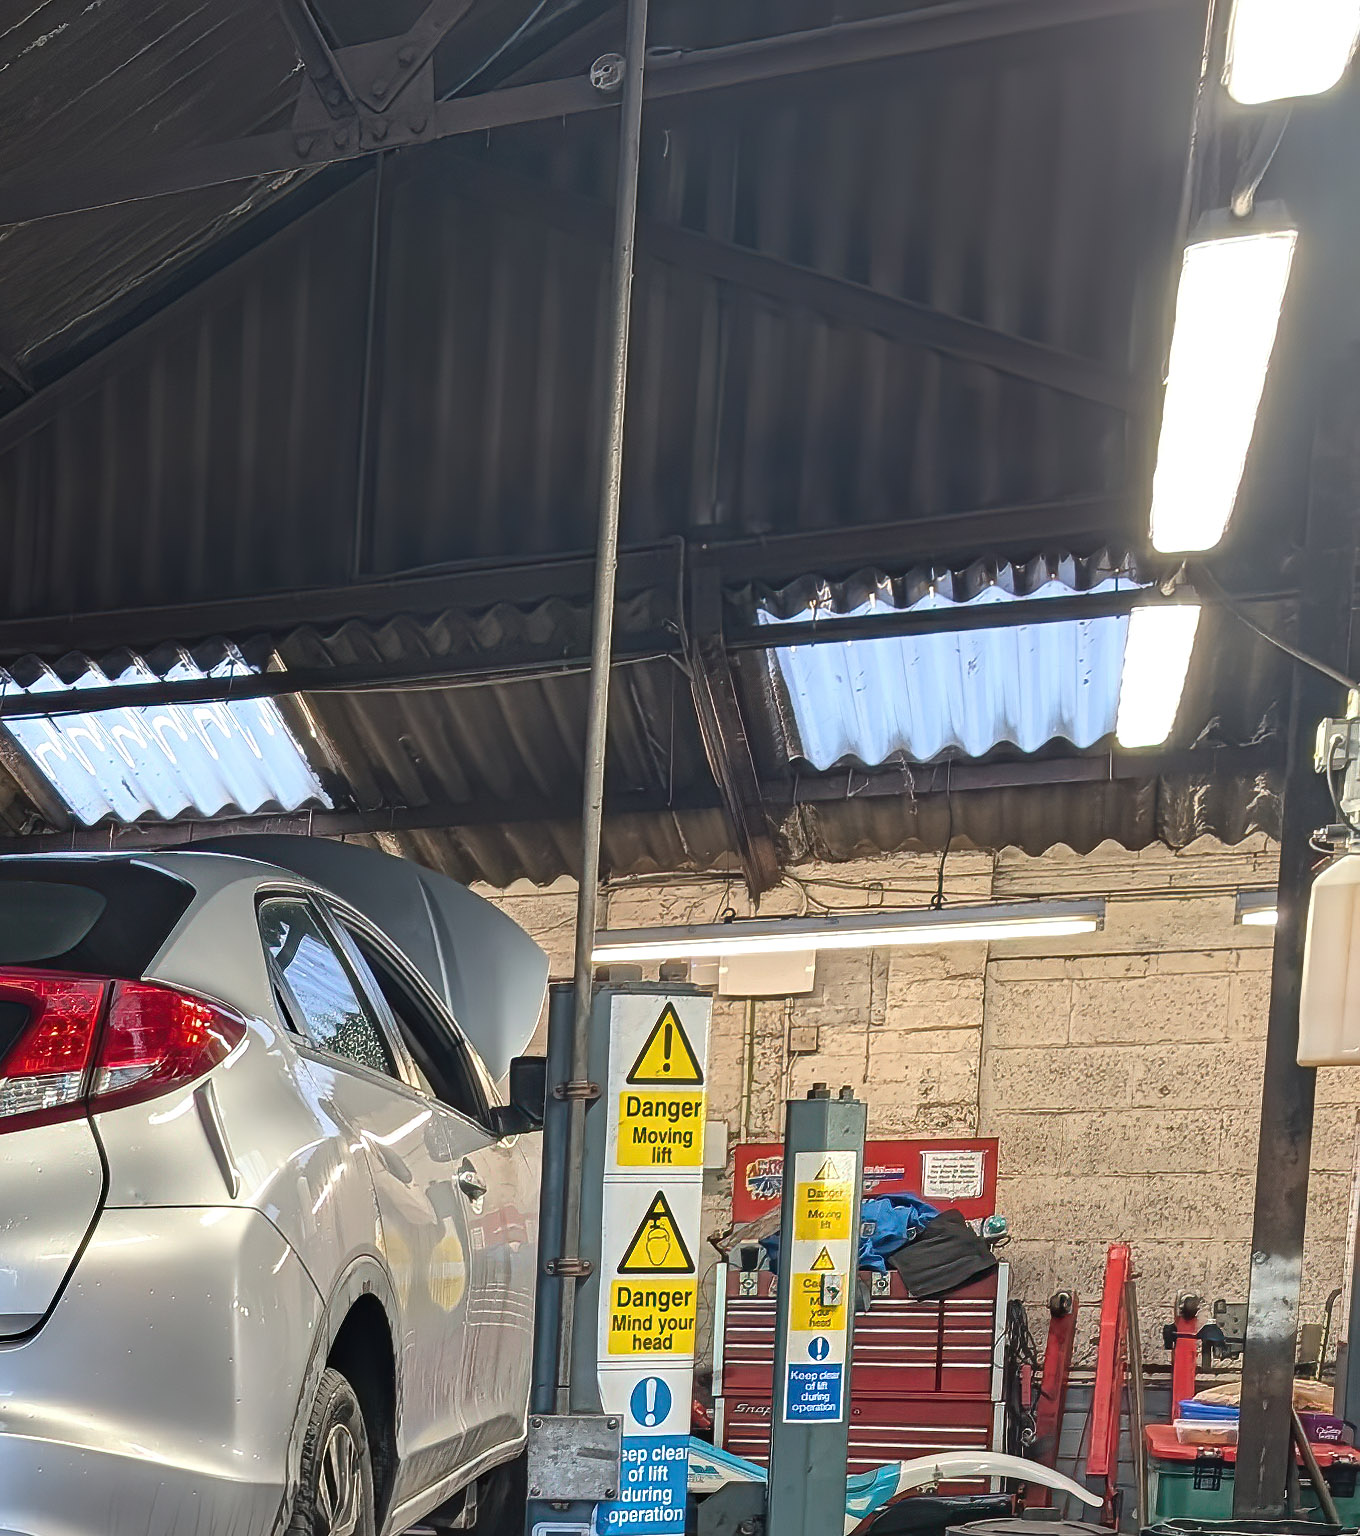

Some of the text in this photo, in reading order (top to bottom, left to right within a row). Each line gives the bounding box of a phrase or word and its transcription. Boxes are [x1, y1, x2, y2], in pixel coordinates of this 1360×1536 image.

[626, 1095, 702, 1123] Danger
[632, 1126, 694, 1148] Moving
[651, 1146, 673, 1164] lift
[616, 1286, 693, 1313] Danger
[611, 1314, 695, 1336] Mind your
[632, 1333, 673, 1351] head
[790, 1370, 818, 1382] Keep
[805, 1381, 816, 1391] of
[800, 1391, 831, 1404] during
[791, 1403, 837, 1414] operation
[621, 1444, 689, 1466] eep clear
[628, 1465, 645, 1482] of
[648, 1465, 669, 1482] lift
[621, 1485, 673, 1506] during
[608, 1505, 684, 1527] operation
